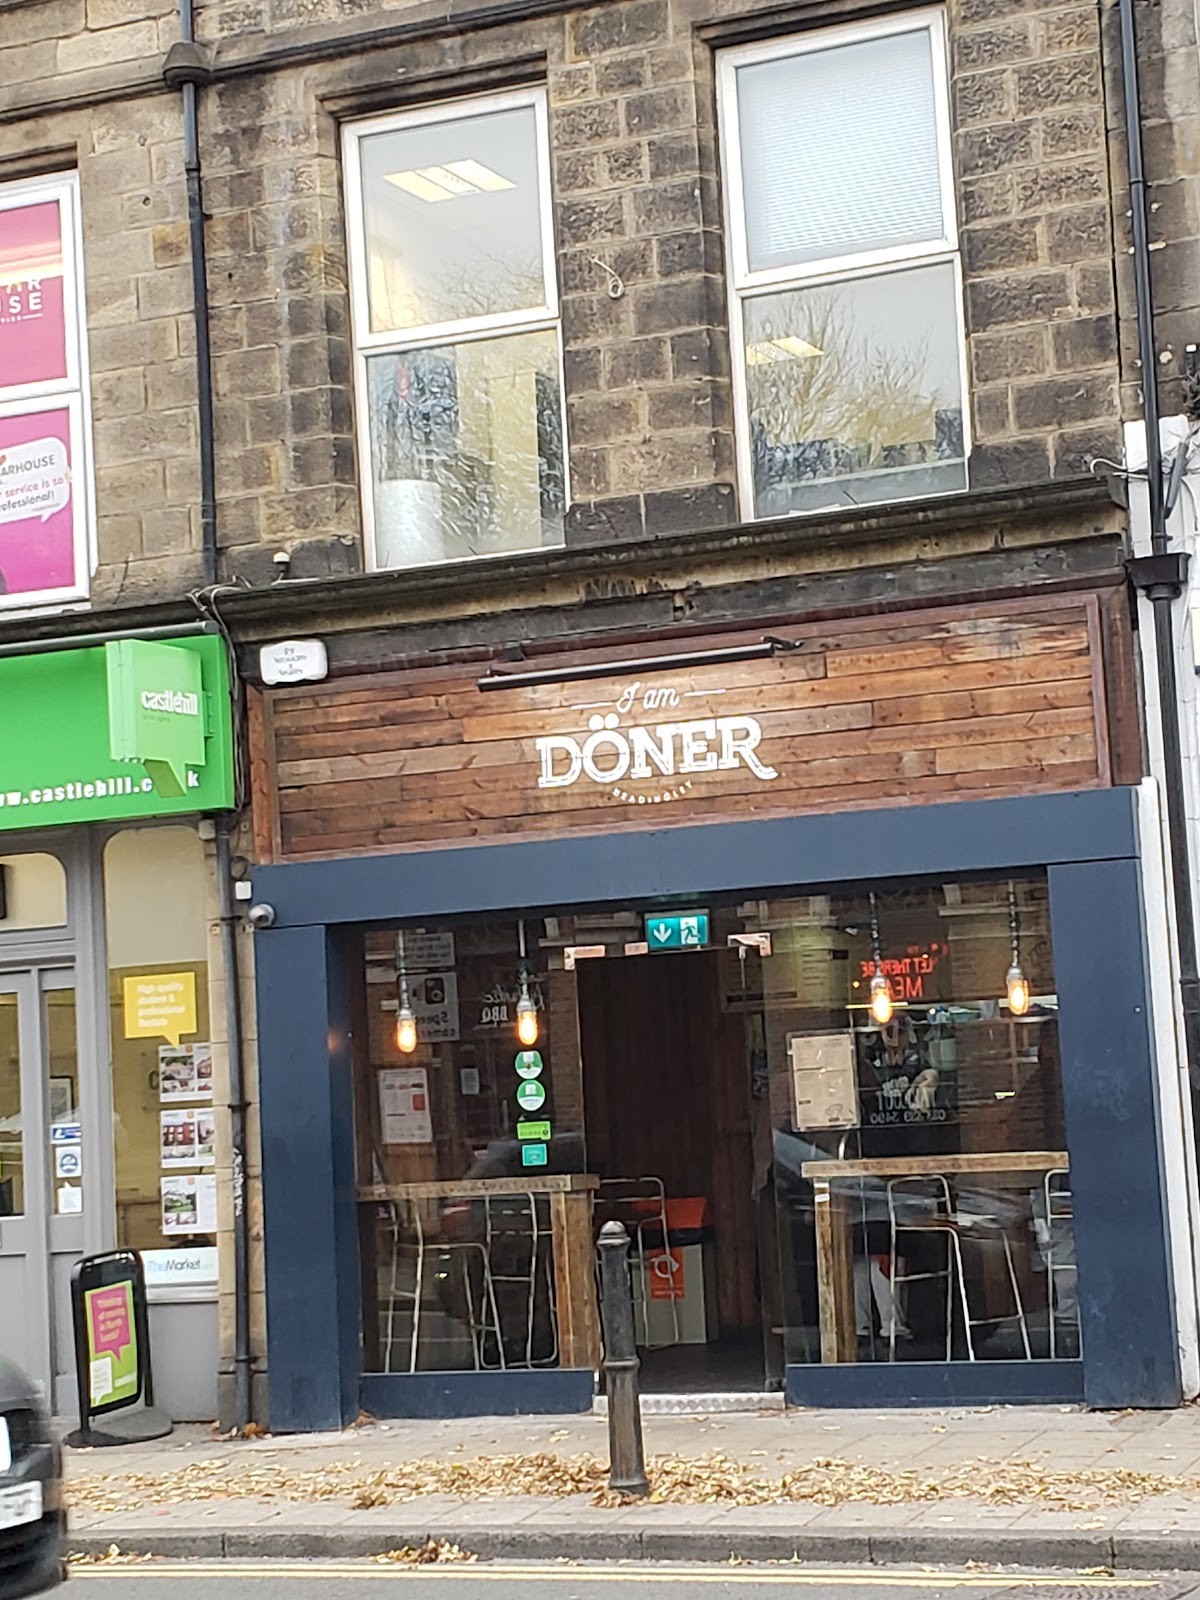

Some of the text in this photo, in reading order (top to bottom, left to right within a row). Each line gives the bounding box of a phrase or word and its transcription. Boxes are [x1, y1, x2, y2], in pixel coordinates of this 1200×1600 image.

[0, 292, 42, 314] SE
[0, 454, 55, 476] ARHOUSE
[142, 690, 199, 717] castlehill
[642, 686, 680, 709] am
[535, 713, 779, 789] DÖNER
